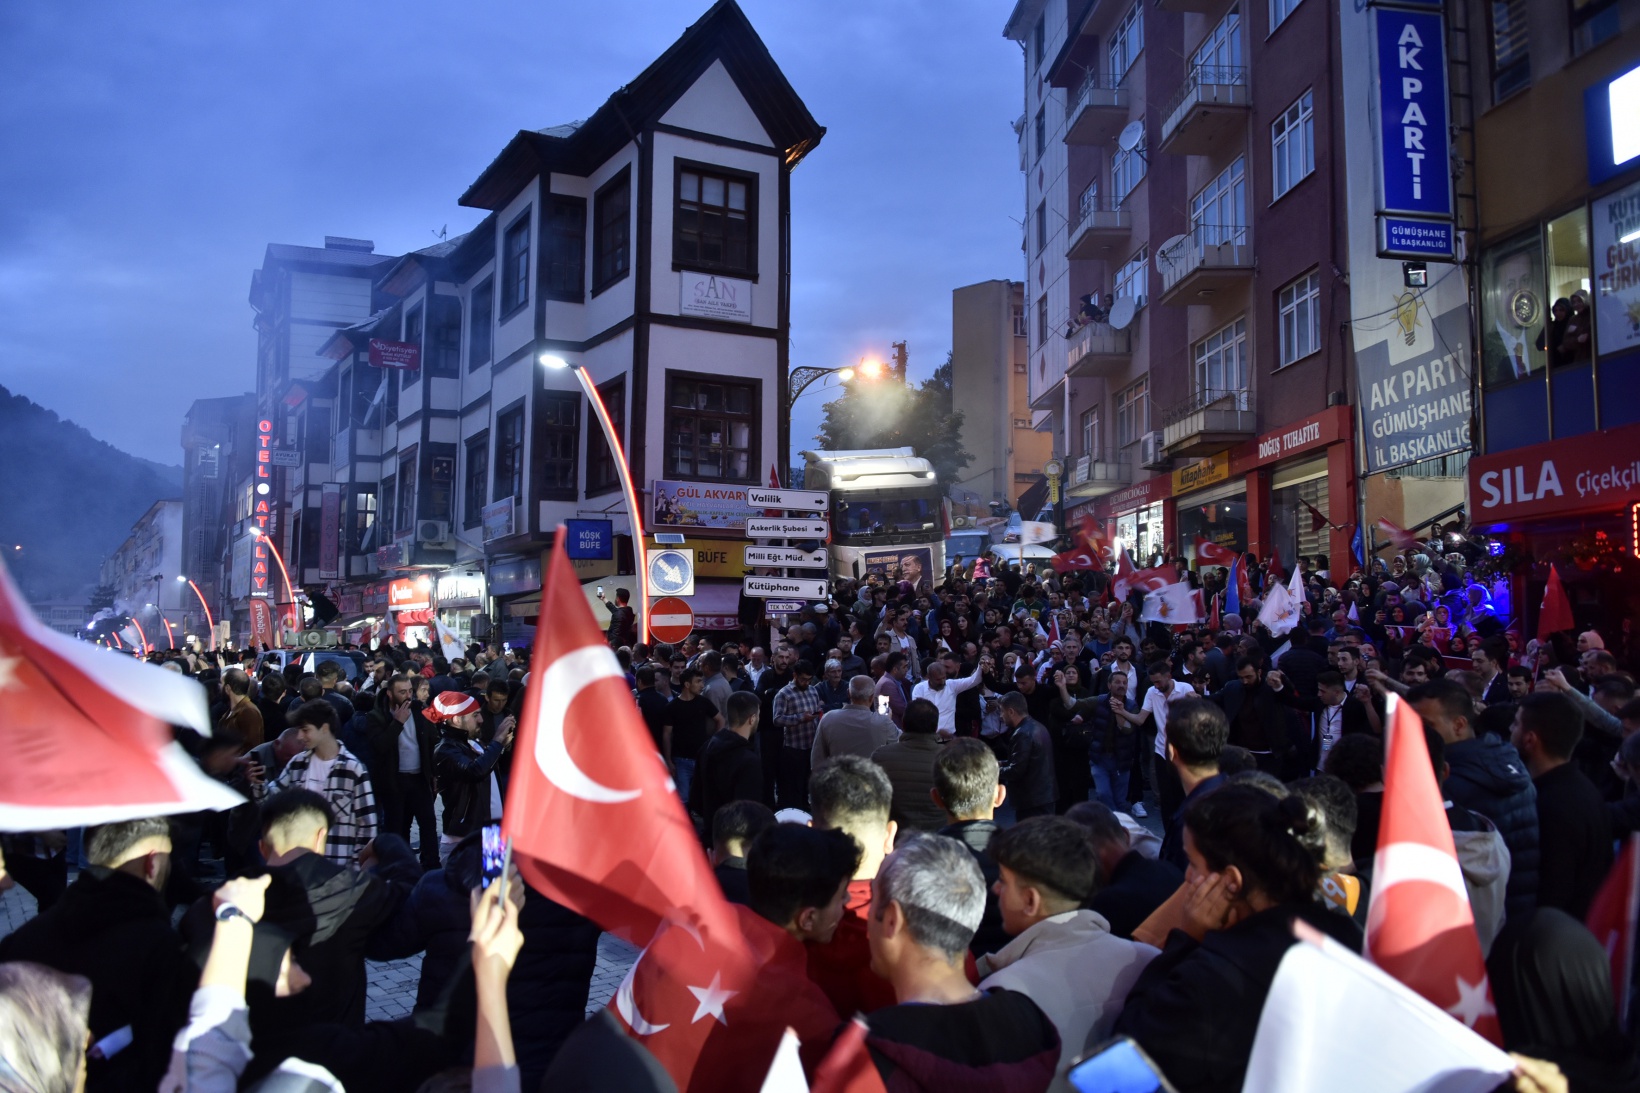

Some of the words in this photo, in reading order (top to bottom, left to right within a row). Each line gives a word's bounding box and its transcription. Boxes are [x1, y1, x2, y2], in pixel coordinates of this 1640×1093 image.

[1398, 24, 1424, 71] AK
[1401, 77, 1428, 200] PARTİ
[1391, 226, 1446, 239] GÜMÜŞHANE
[1392, 237, 1400, 245] İL
[1401, 237, 1447, 248] BAŞKANLIĞI
[693, 275, 736, 301] SAN
[380, 343, 418, 354] Diyetisyen
[1370, 375, 1398, 411] AK
[1403, 343, 1467, 400] PARTİ
[1372, 389, 1472, 439] GÜMÜŞHANE
[258, 419, 272, 478] OTEL
[1258, 436, 1281, 458] DOĞUŞ
[1282, 421, 1320, 451] TUHAFİYE
[1375, 446, 1388, 468] İL
[1390, 420, 1472, 462] BAŞKANLIĞ
[1180, 462, 1216, 487] kitaphane
[1479, 460, 1563, 508] SILA
[677, 485, 700, 499] GÜL
[751, 494, 782, 504] Valilik
[579, 530, 601, 541] KÖŞK
[750, 524, 781, 532] Askerlik
[782, 525, 808, 534] Şubesi
[253, 500, 269, 589] ATALAY
[579, 539, 601, 549] BÜFE
[697, 548, 727, 563] BÜFE
[748, 552, 766, 560] Milli
[767, 553, 783, 563] Eğt.
[785, 554, 805, 562] Müd.
[748, 582, 800, 592] Kütüphane
